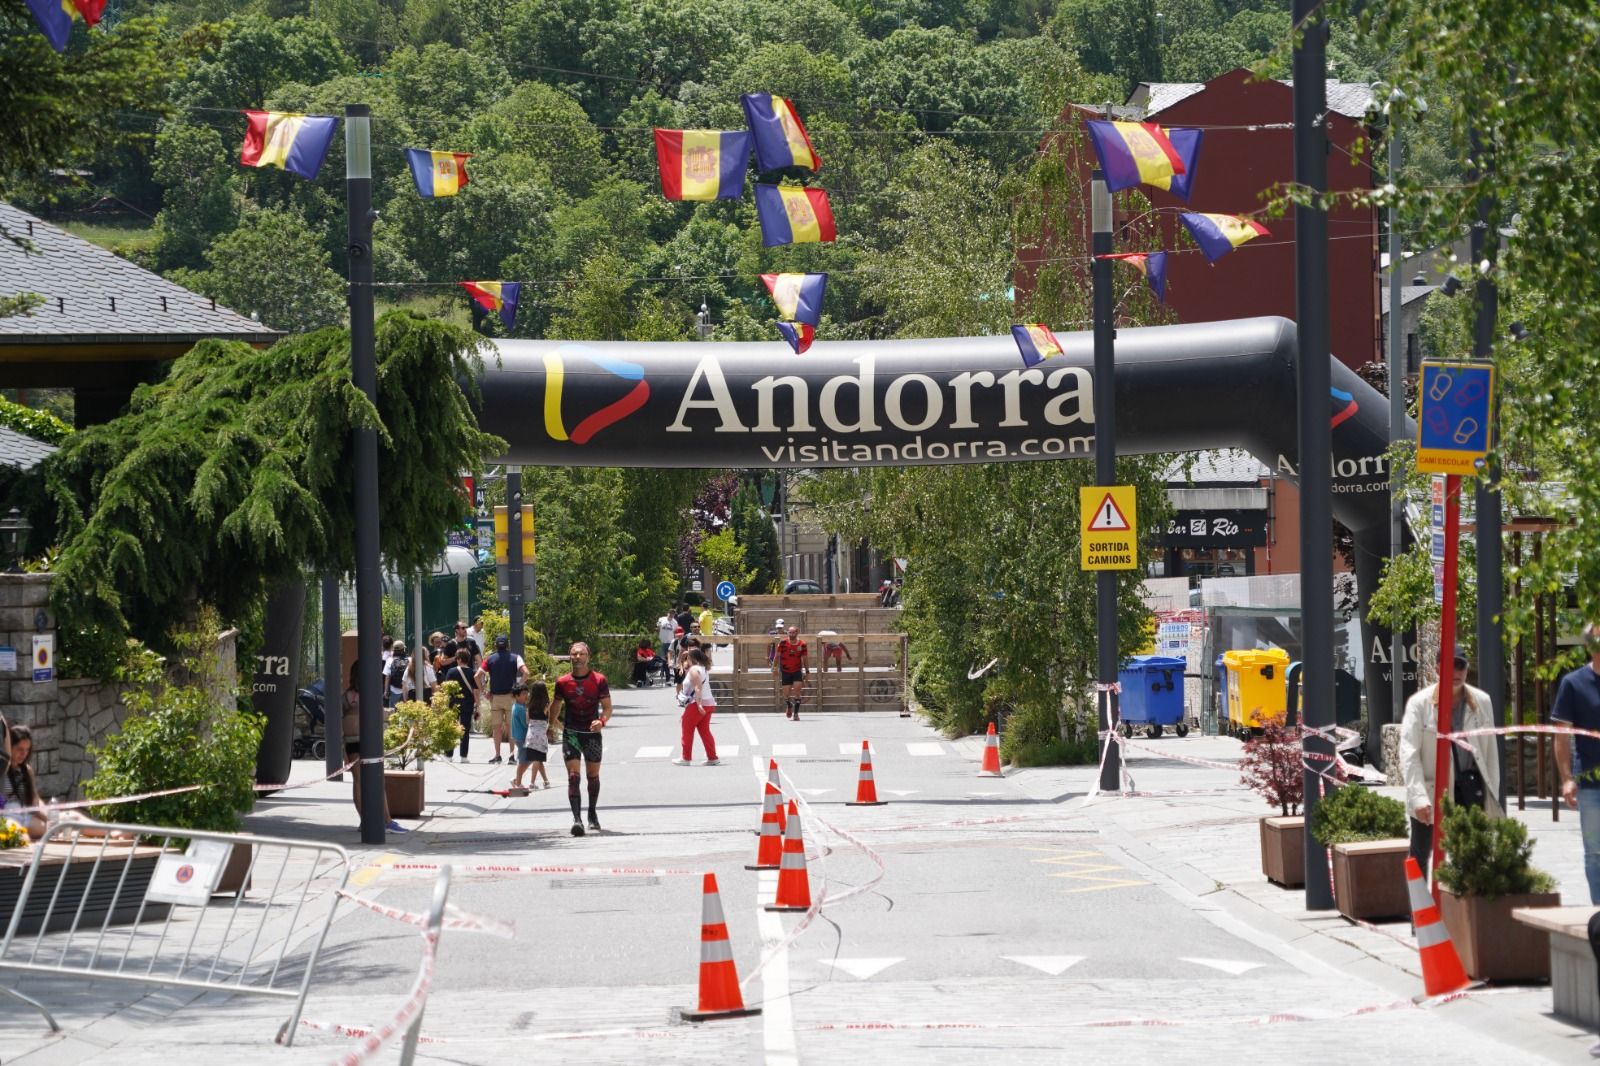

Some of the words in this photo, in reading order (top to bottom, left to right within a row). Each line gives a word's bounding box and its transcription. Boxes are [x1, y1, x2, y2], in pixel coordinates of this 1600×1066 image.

[666, 353, 1095, 433] Andorra
[761, 435, 1096, 463] visitandorra.com
[1167, 520, 1187, 535] Bar
[1191, 520, 1207, 535] El
[1089, 543, 1130, 552] SORTIDA
[1088, 555, 1132, 564] CAMIONS
